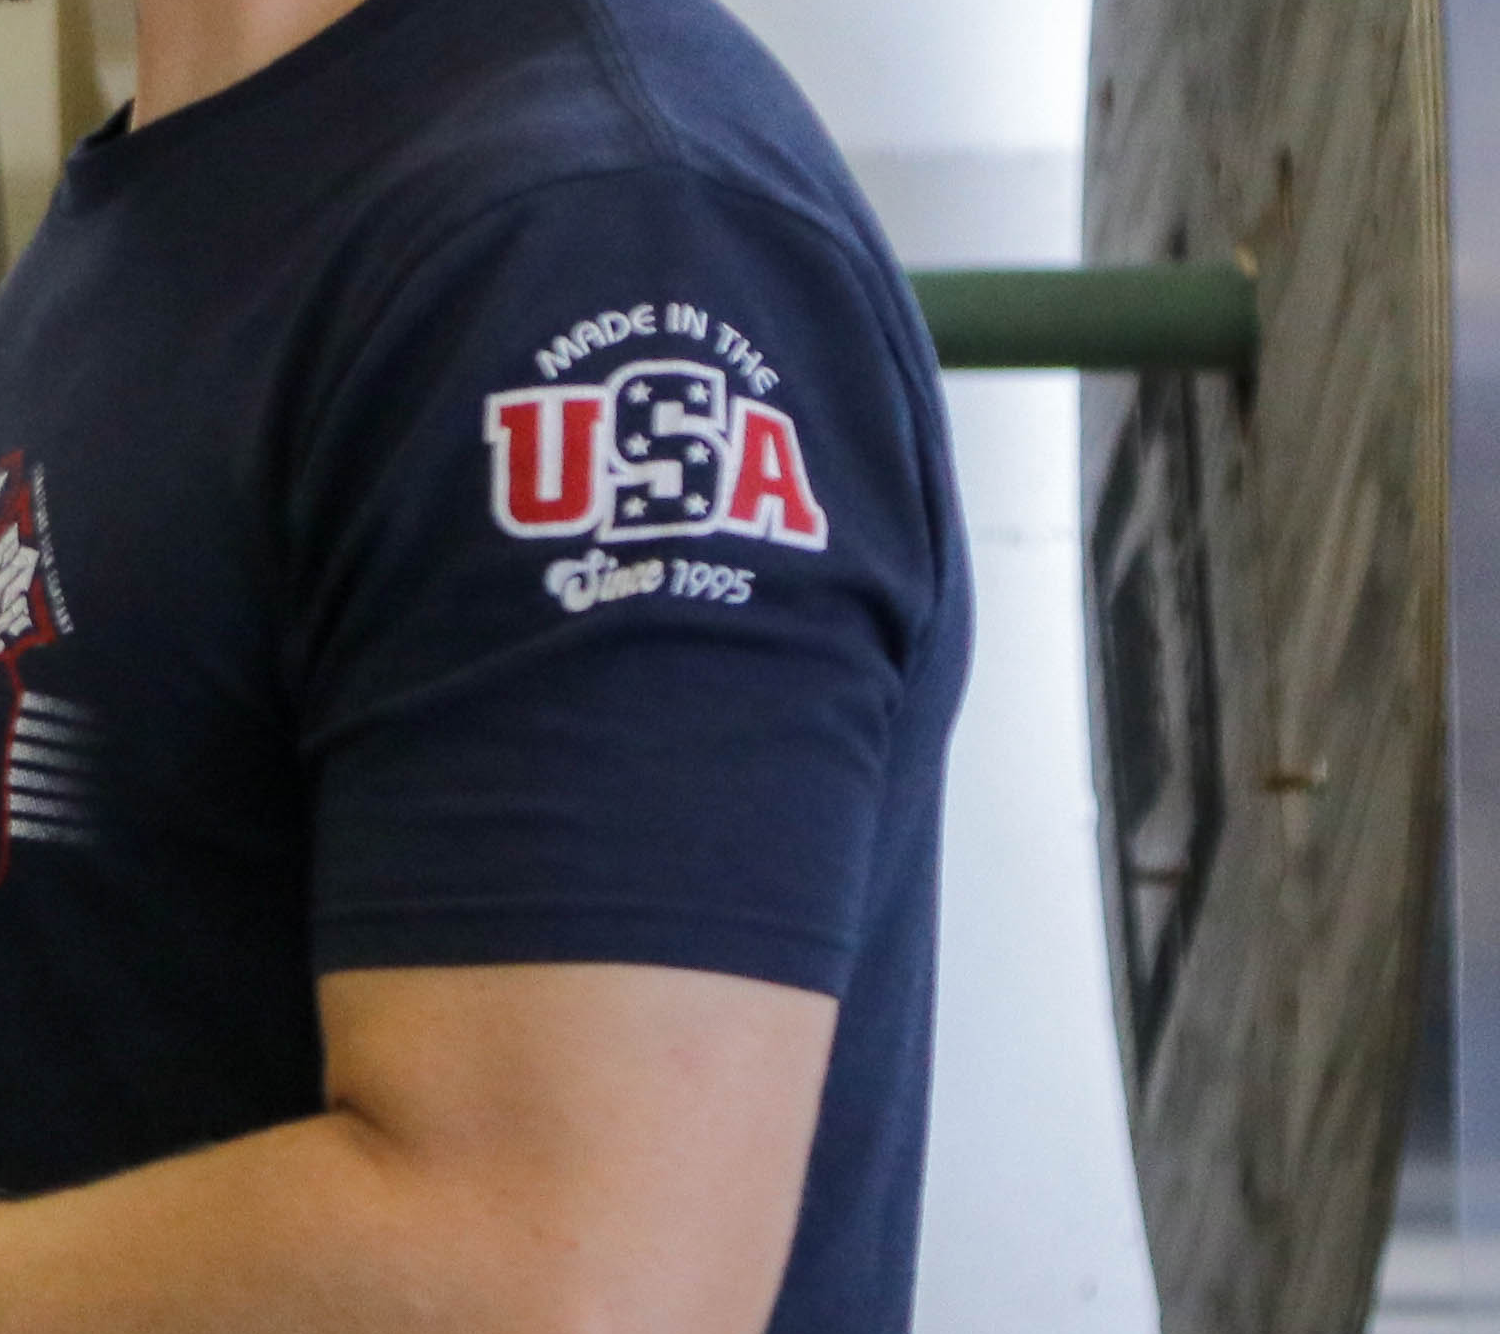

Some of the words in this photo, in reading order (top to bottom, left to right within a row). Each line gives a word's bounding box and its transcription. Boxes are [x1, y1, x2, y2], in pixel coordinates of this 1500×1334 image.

[536, 303, 657, 380] MADE
[664, 302, 709, 341] IN
[714, 322, 781, 396] THE
[483, 358, 829, 553] USA
[545, 548, 666, 613] Since
[668, 558, 757, 604] 1995
